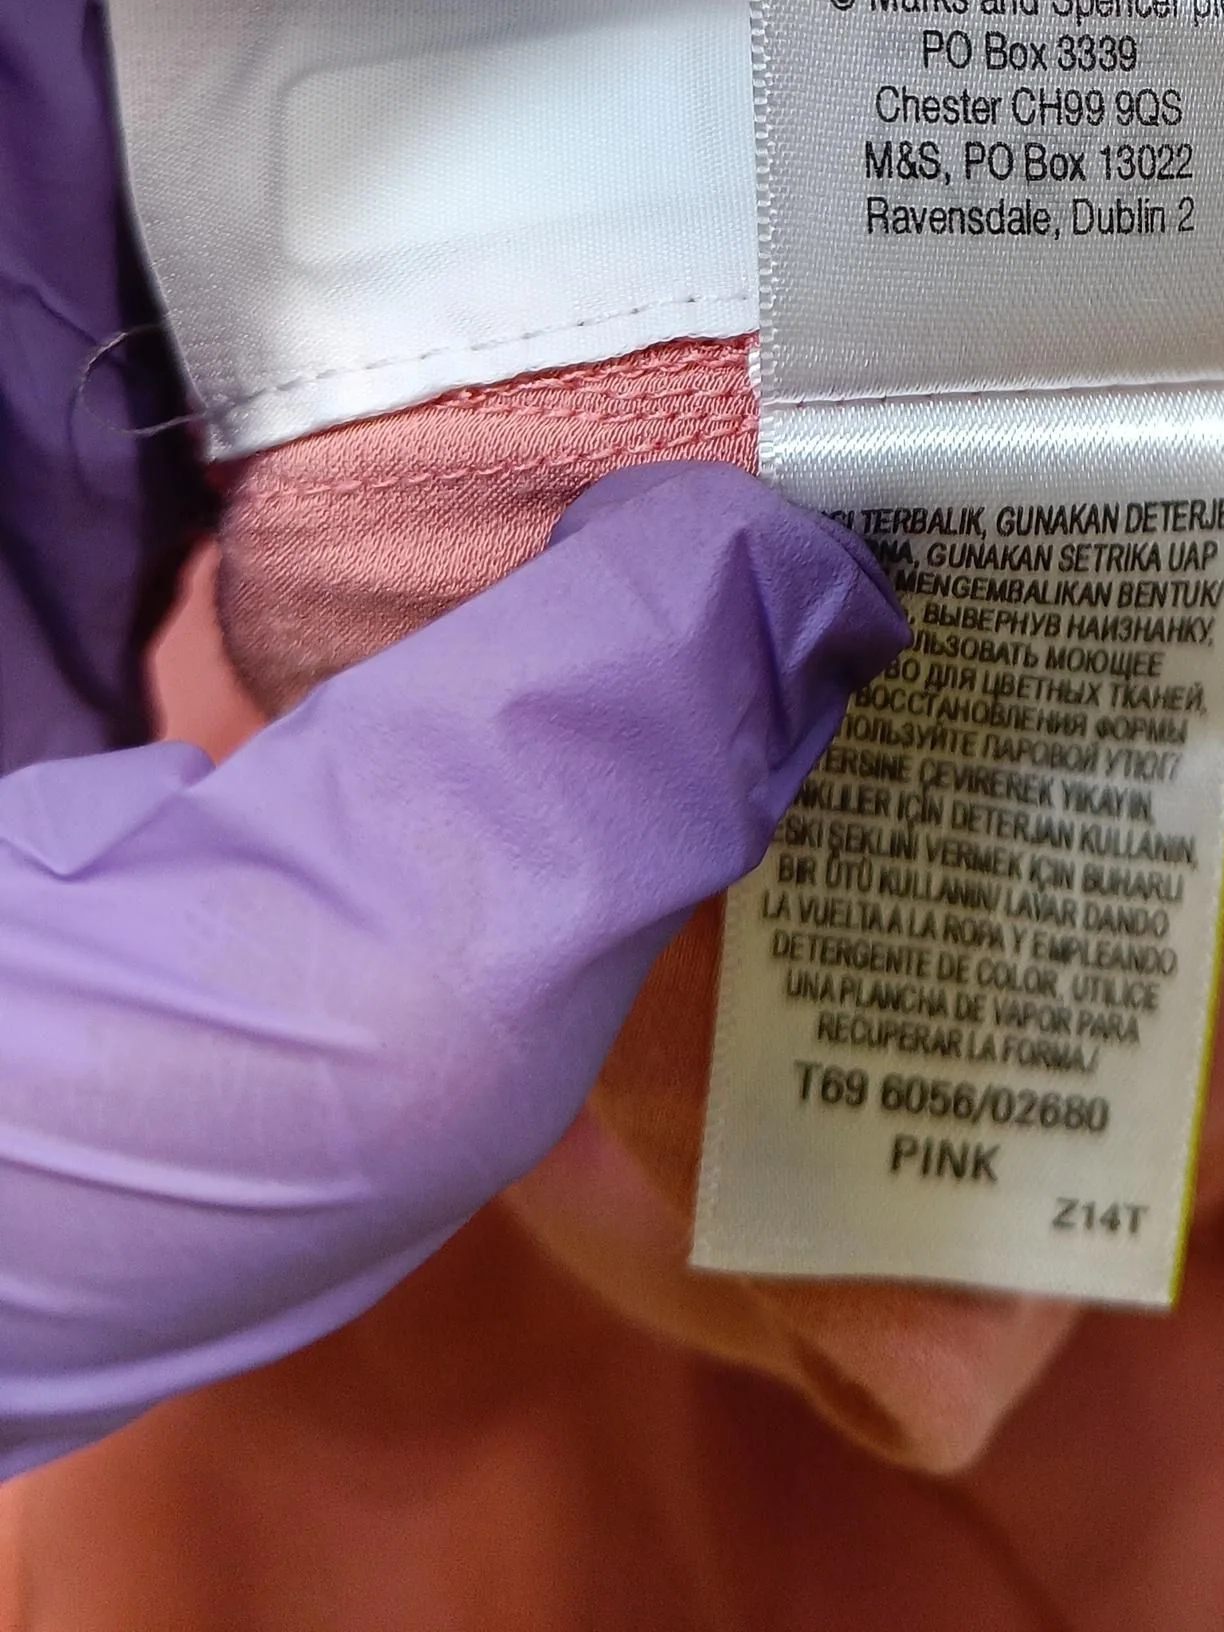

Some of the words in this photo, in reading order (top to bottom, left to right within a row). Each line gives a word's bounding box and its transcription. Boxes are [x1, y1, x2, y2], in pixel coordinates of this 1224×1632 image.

[922, 30, 972, 69] PO
[986, 33, 1048, 71] Box
[1057, 34, 1138, 72] 3339
[875, 85, 1003, 126] Chester
[1012, 88, 1105, 127] CH99
[1116, 88, 1184, 128] 9QS
[866, 141, 951, 184] M&S,
[966, 143, 1014, 181] PO
[1026, 143, 1086, 182] Box
[1102, 143, 1193, 182] 13022
[867, 196, 1060, 240] Ravensdale,
[1072, 197, 1166, 235] Dublin
[1178, 198, 1195, 232] 2
[861, 506, 987, 540] TERBALIK,
[996, 501, 1120, 537] GUNAKAN
[927, 541, 1053, 572] GUNAKAN
[1058, 541, 1161, 572] SETRIKA
[1169, 540, 1219, 571] UAP
[896, 569, 1113, 608] MENGEMBALIKAN
[911, 629, 1040, 669] ЛЬЗОВАТЬ
[762, 890, 791, 920] LA
[794, 1061, 869, 1106] T69
[881, 1073, 1110, 1133] 6056/02680
[889, 1135, 1000, 1182] PINK
[1052, 1197, 1148, 1235] Z14T
